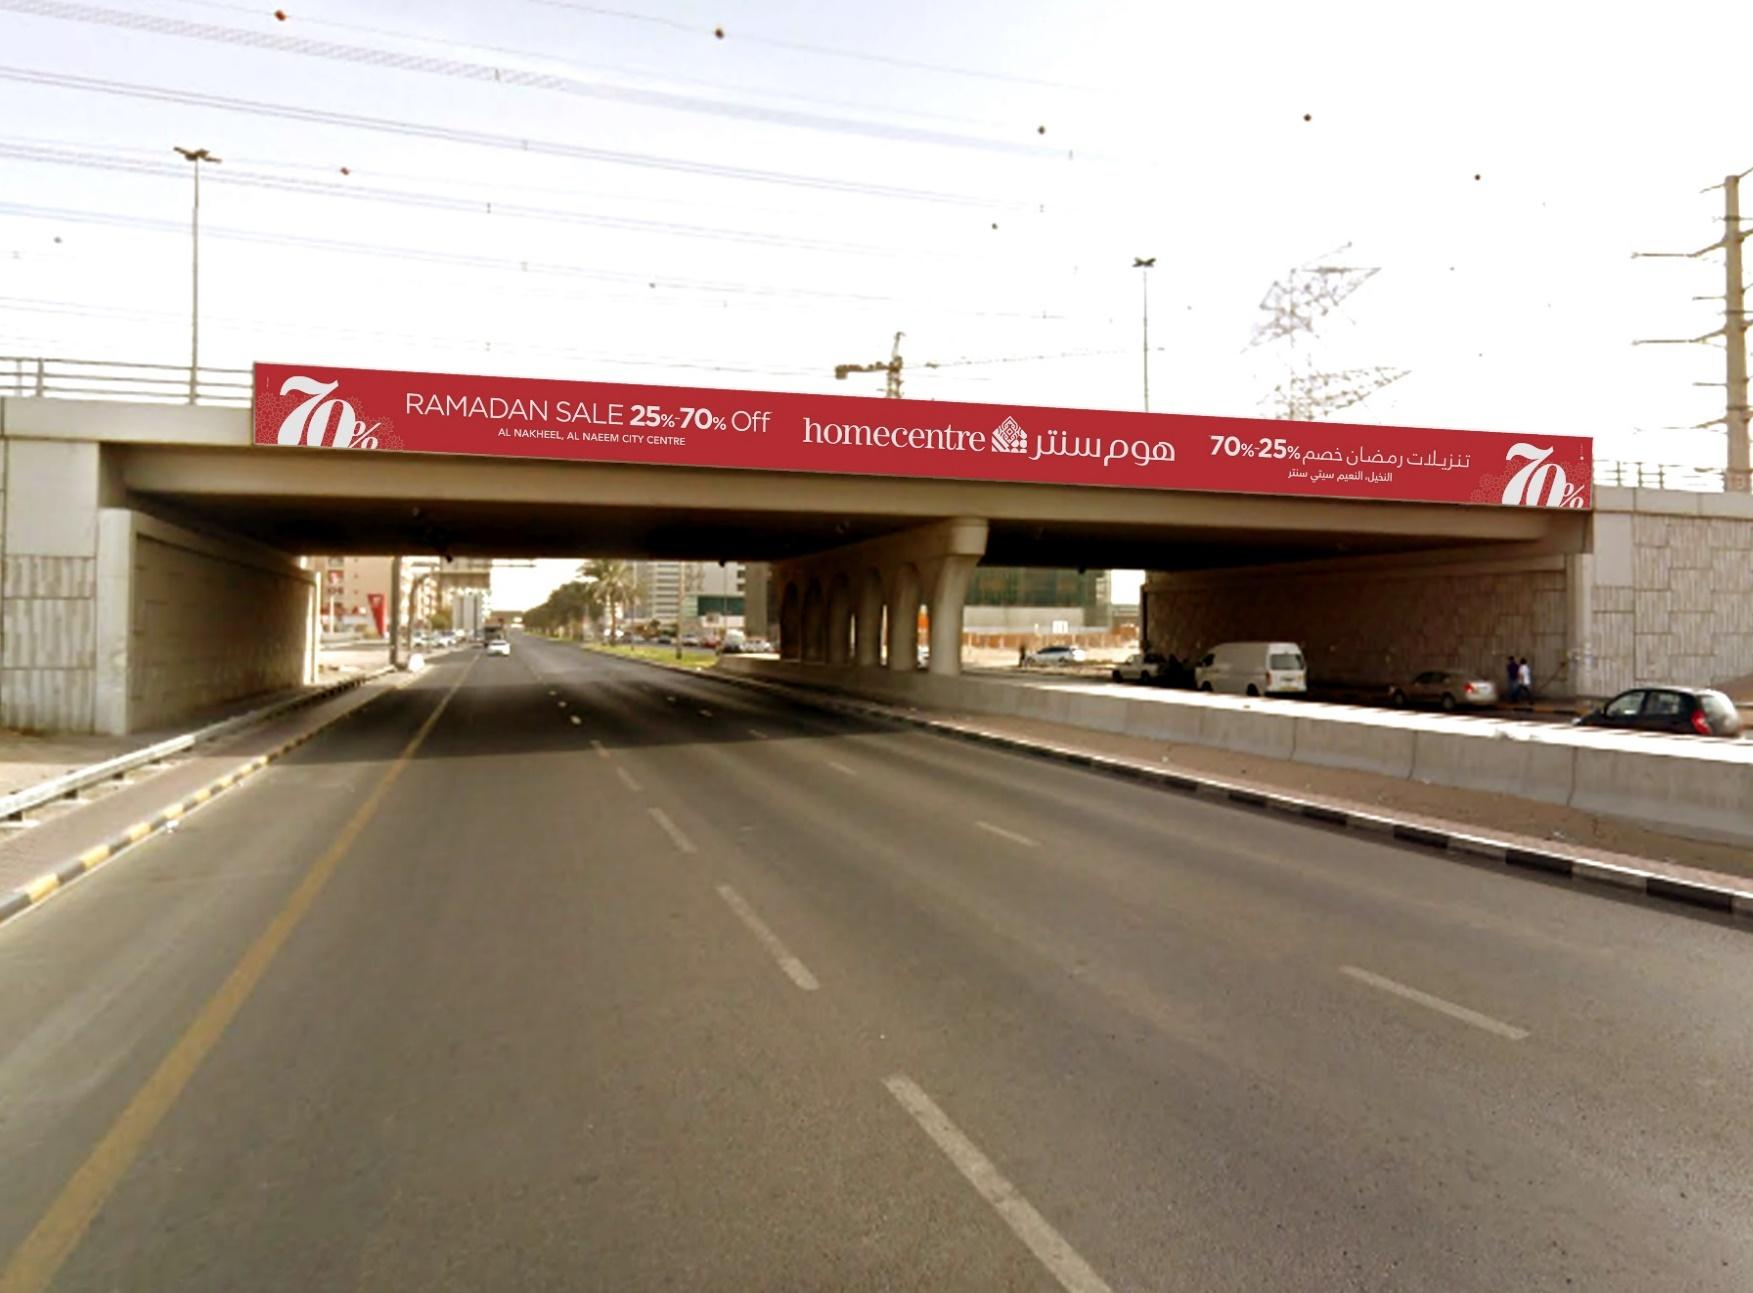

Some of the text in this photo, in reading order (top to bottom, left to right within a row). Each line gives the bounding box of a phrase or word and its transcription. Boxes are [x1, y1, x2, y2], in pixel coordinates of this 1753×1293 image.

[277, 375, 382, 449] 70%
[406, 392, 548, 422] RAMADAN
[556, 401, 624, 426] SALE
[731, 410, 773, 433] Off
[498, 427, 686, 446] AL NAKHEEL, AL NAEEM CITY CENTRE
[802, 417, 986, 452] homecentre
[1028, 429, 1176, 467] هوم سنتر
[1302, 446, 1343, 466] خصم
[1346, 446, 1404, 468] رمضان
[1406, 449, 1472, 471] تنزيلات
[1287, 469, 1308, 479] سنتر
[1310, 470, 1335, 483] سيتي
[1336, 471, 1363, 482] النعيم
[1501, 442, 1586, 510] 70%
